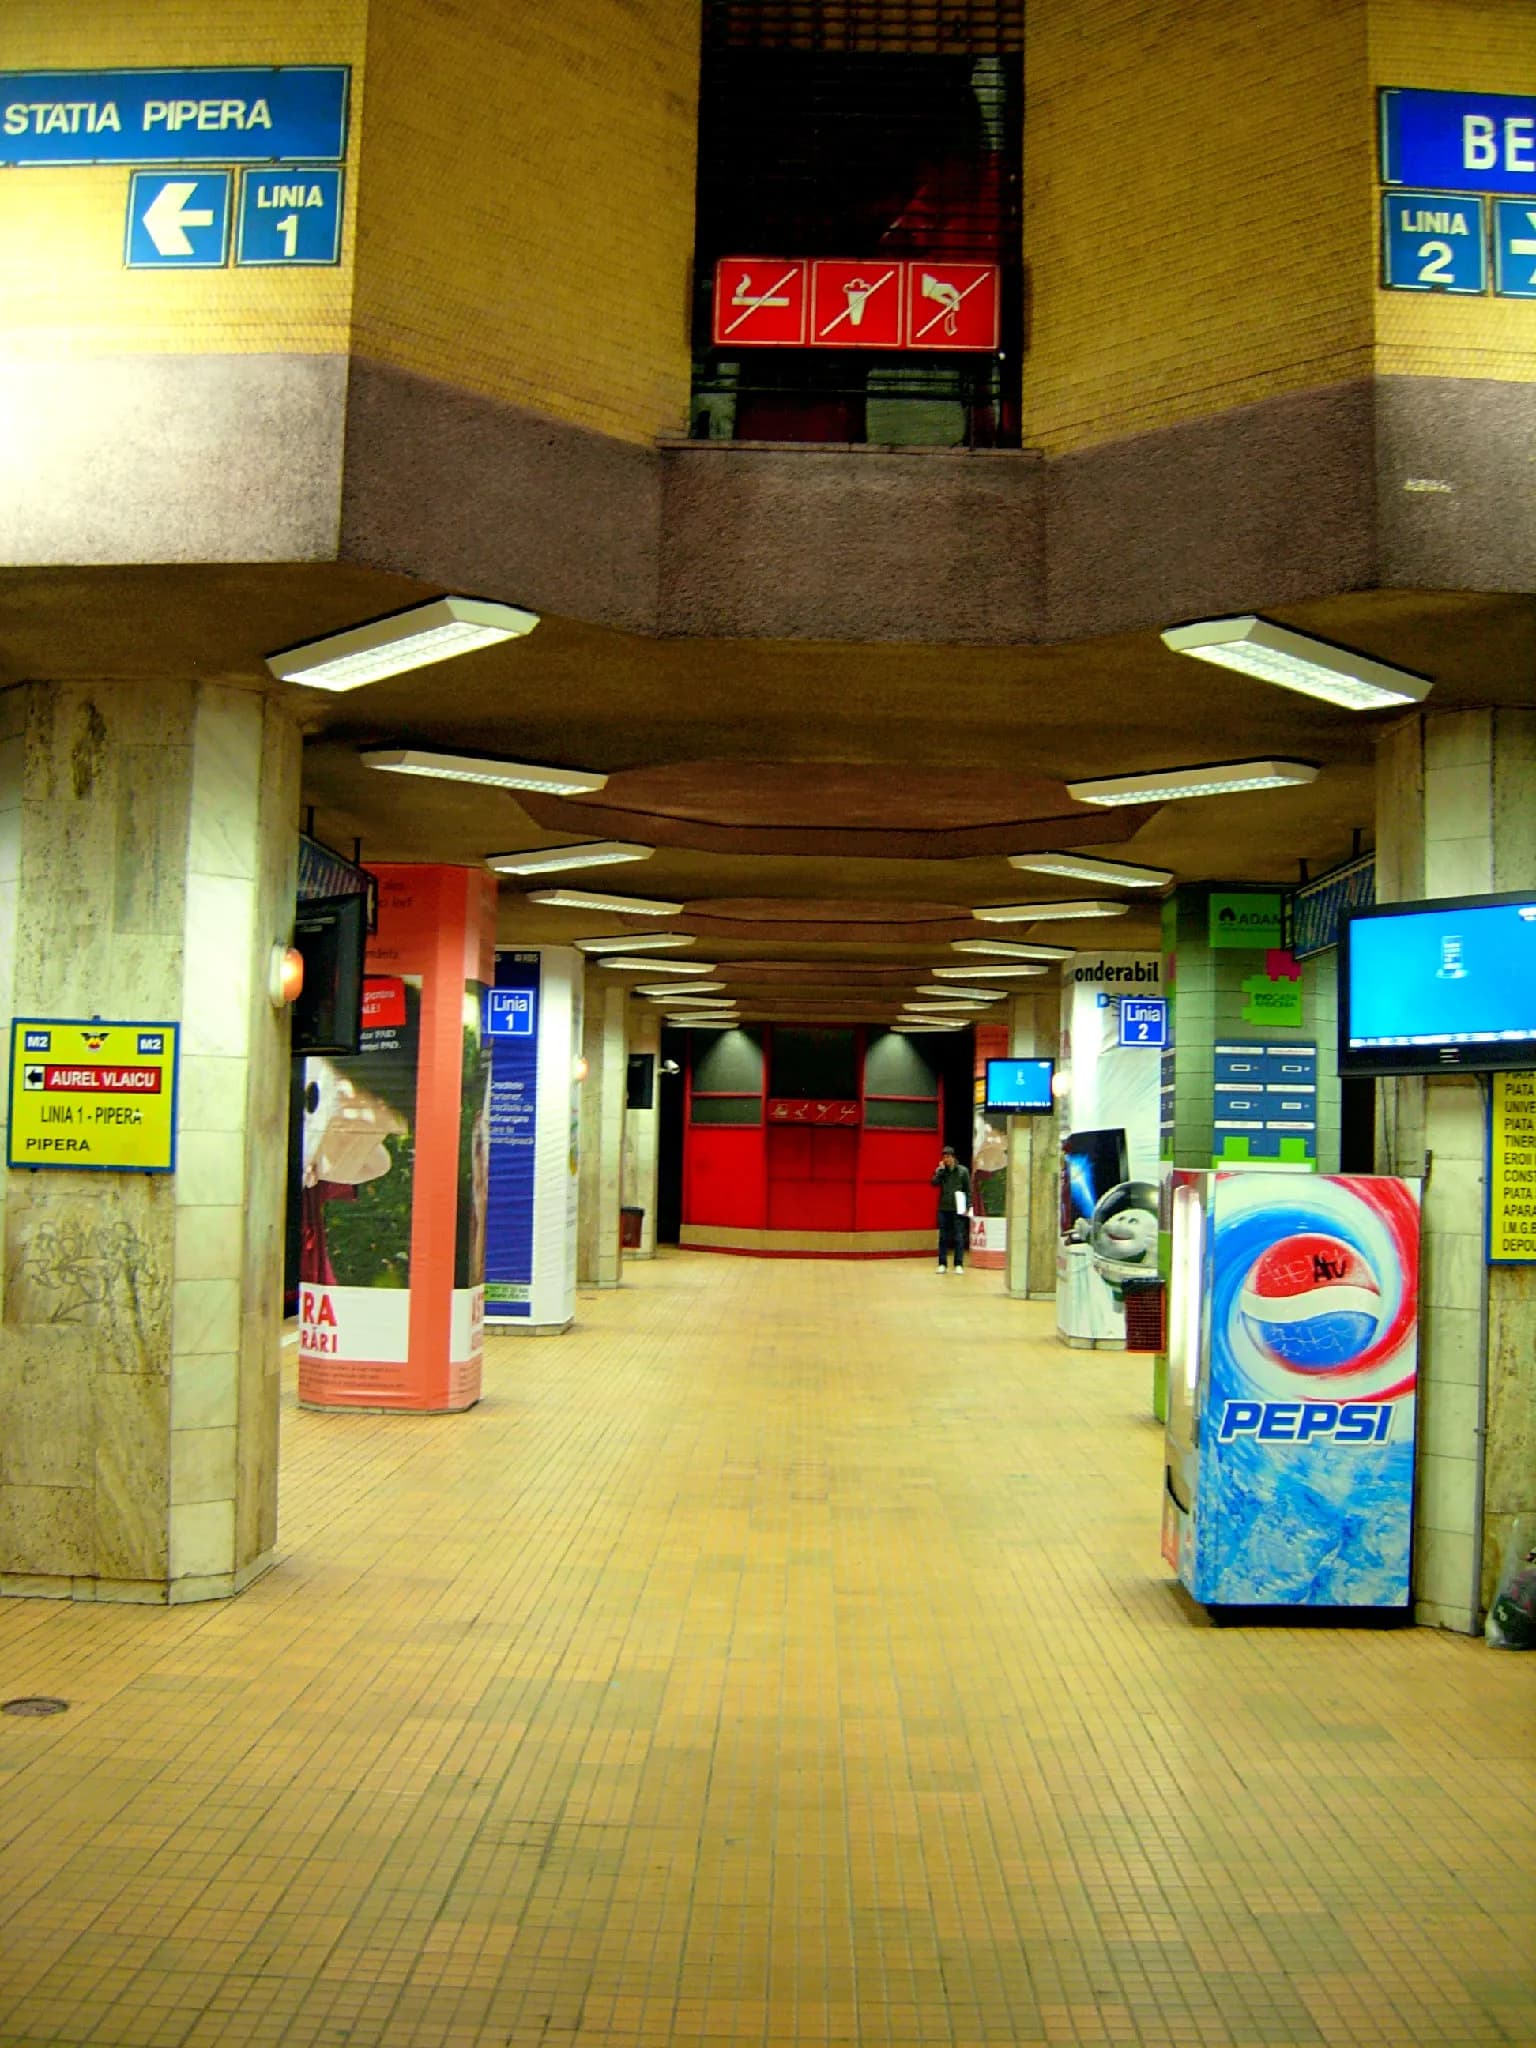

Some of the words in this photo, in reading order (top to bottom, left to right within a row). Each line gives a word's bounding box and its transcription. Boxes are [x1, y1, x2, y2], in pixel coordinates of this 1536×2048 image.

[3, 102, 122, 135] STATIA
[142, 99, 272, 131] PIPERA
[1462, 114, 1536, 172] BE
[257, 186, 324, 209] LINIA
[1400, 210, 1470, 236] LINIA
[276, 215, 298, 257] 1
[1416, 240, 1456, 284] 2
[493, 995, 528, 1012] Linia
[505, 1013, 515, 1031] 1
[1127, 1004, 1161, 1022] Linia
[1137, 1023, 1149, 1041] 2
[27, 1036, 49, 1048] M2
[140, 1038, 162, 1050] M2
[51, 1071, 99, 1087] AUREL
[103, 1071, 155, 1087] VLAICU
[1505, 1083, 1534, 1097] PIATA
[41, 1106, 73, 1123] LINIA
[77, 1106, 83, 1123] 1
[95, 1107, 142, 1125] PIPERA
[1504, 1118, 1534, 1131] PIATA
[26, 1138, 91, 1151] PIPERA
[1504, 1188, 1532, 1200] PIATA
[303, 1292, 337, 1326] RA
[1220, 1402, 1394, 1441] PEPSI
